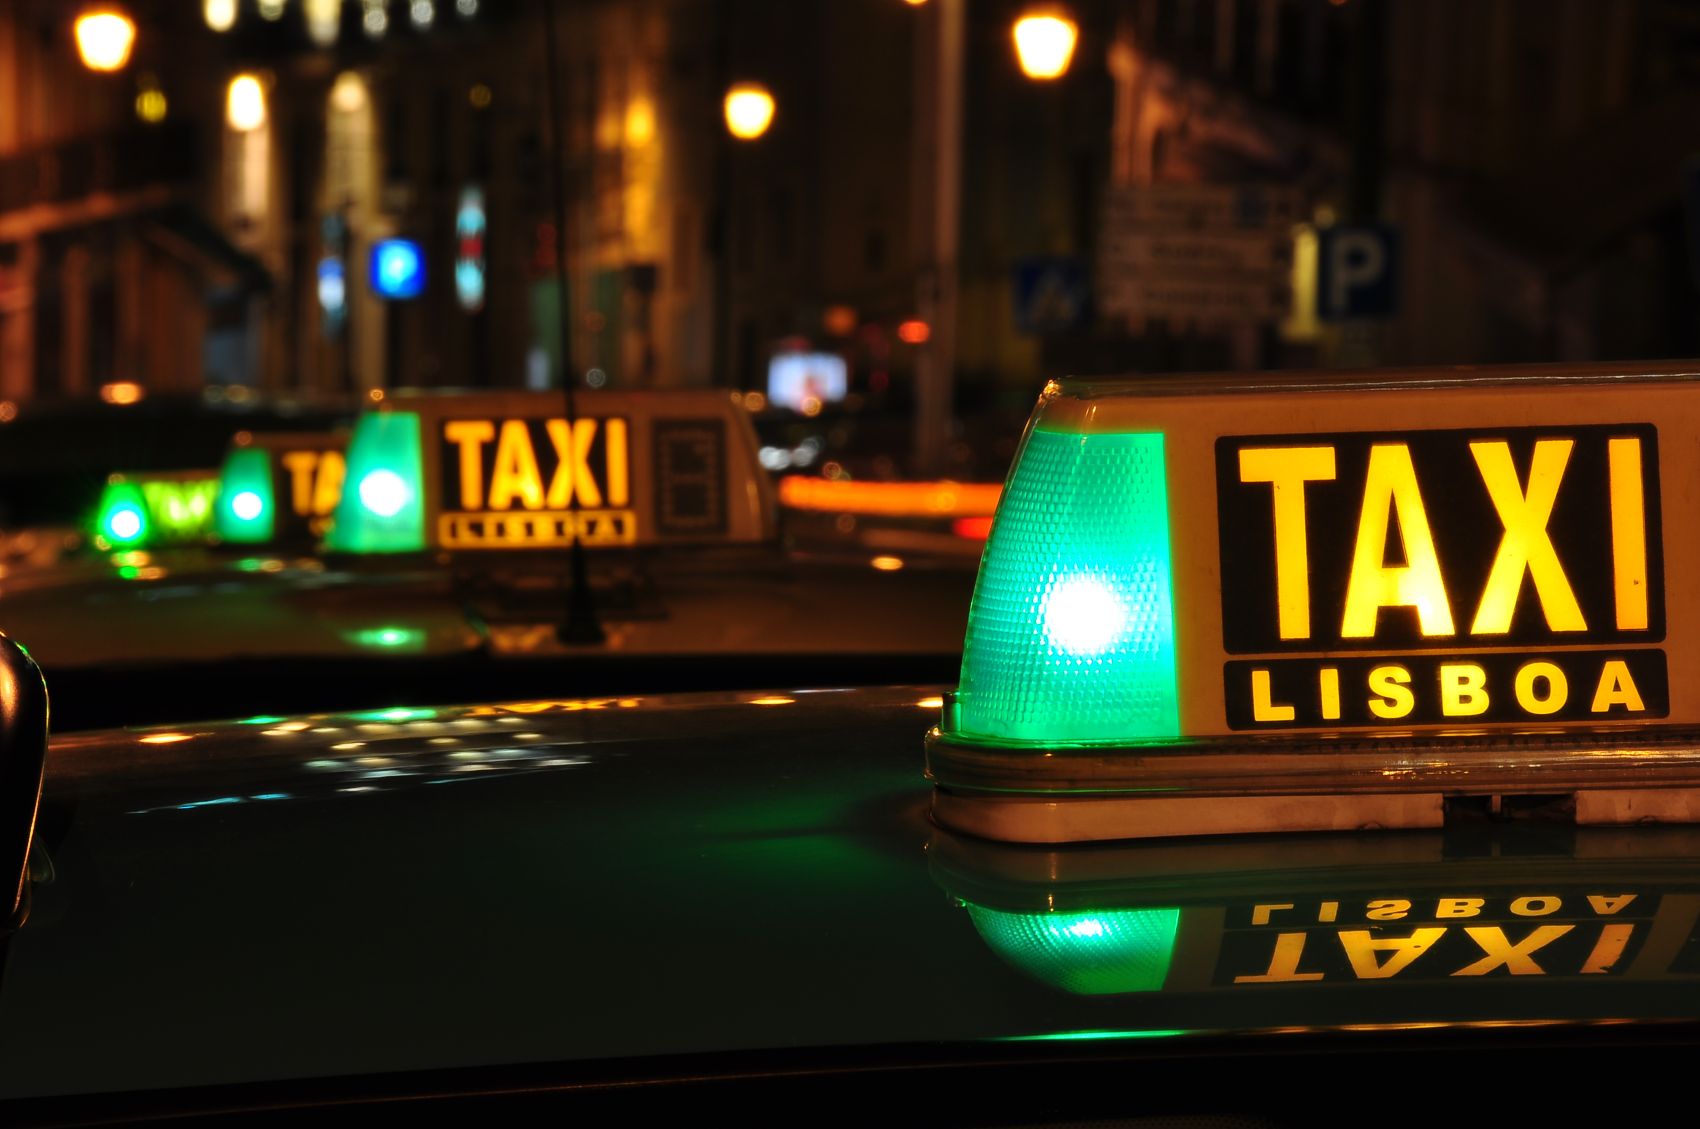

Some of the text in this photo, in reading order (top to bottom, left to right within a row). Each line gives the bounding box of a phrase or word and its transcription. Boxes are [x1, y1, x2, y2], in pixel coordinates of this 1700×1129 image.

[1328, 230, 1388, 316] P
[282, 452, 346, 514] TA
[444, 418, 629, 510] TAXI
[1238, 438, 1648, 640] TAXI
[1252, 660, 1645, 722] LISBOA
